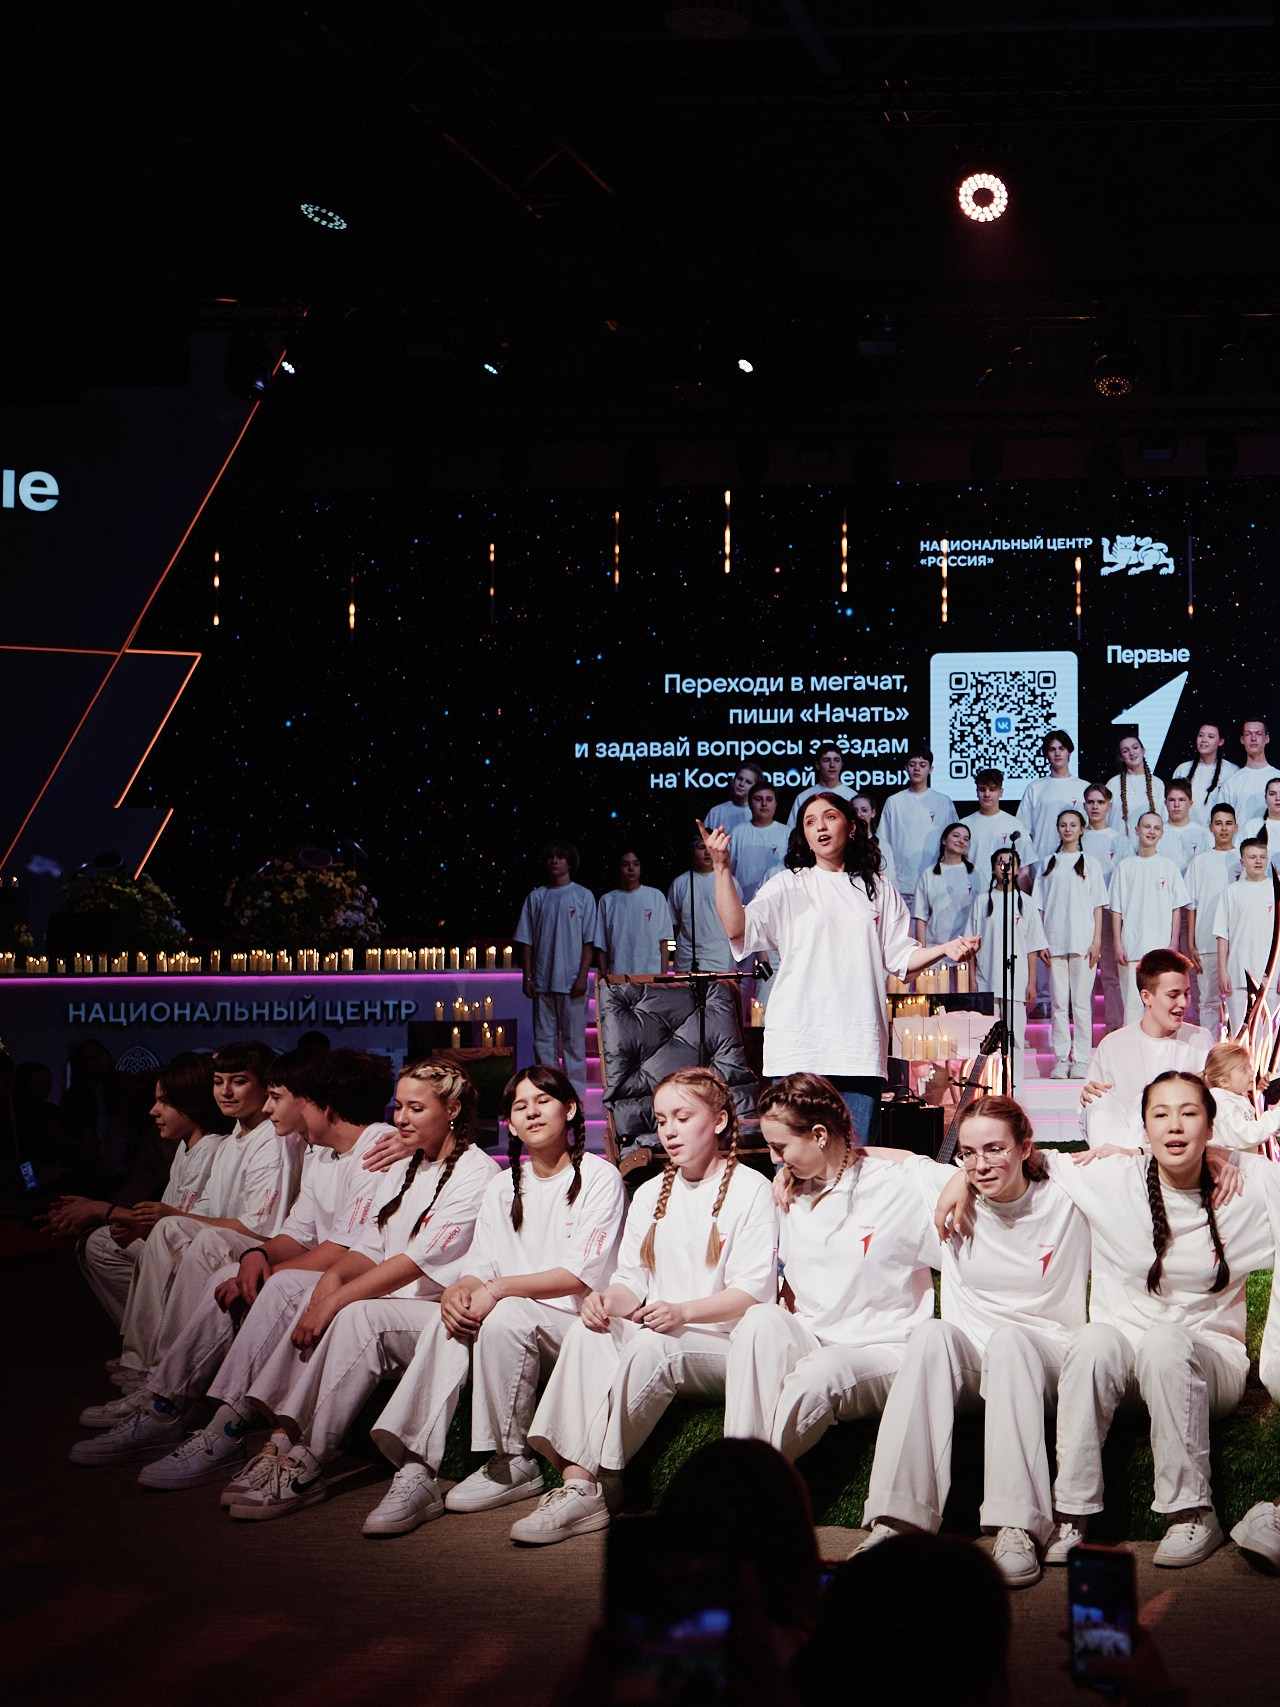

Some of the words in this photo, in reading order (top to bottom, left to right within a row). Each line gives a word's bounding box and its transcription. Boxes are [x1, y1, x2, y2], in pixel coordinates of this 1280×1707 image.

[1046, 537, 1094, 552] ЦЕНТР
[1106, 644, 1191, 669] Первые
[664, 673, 784, 699] Переходи
[790, 676, 804, 692] в
[810, 674, 908, 693] мегачат,
[729, 707, 794, 725] пиши
[799, 702, 911, 724] «Начать»
[574, 742, 589, 759] и
[595, 736, 690, 762] задавай
[697, 739, 803, 762] вопросы
[809, 733, 910, 758] зёздам
[650, 772, 678, 789] на
[684, 766, 816, 789] Косвой
[839, 769, 910, 791] ервых
[68, 993, 317, 1027] НАЦИОНАЛЬНЫЙ
[325, 999, 417, 1025] ЦЕНТР
